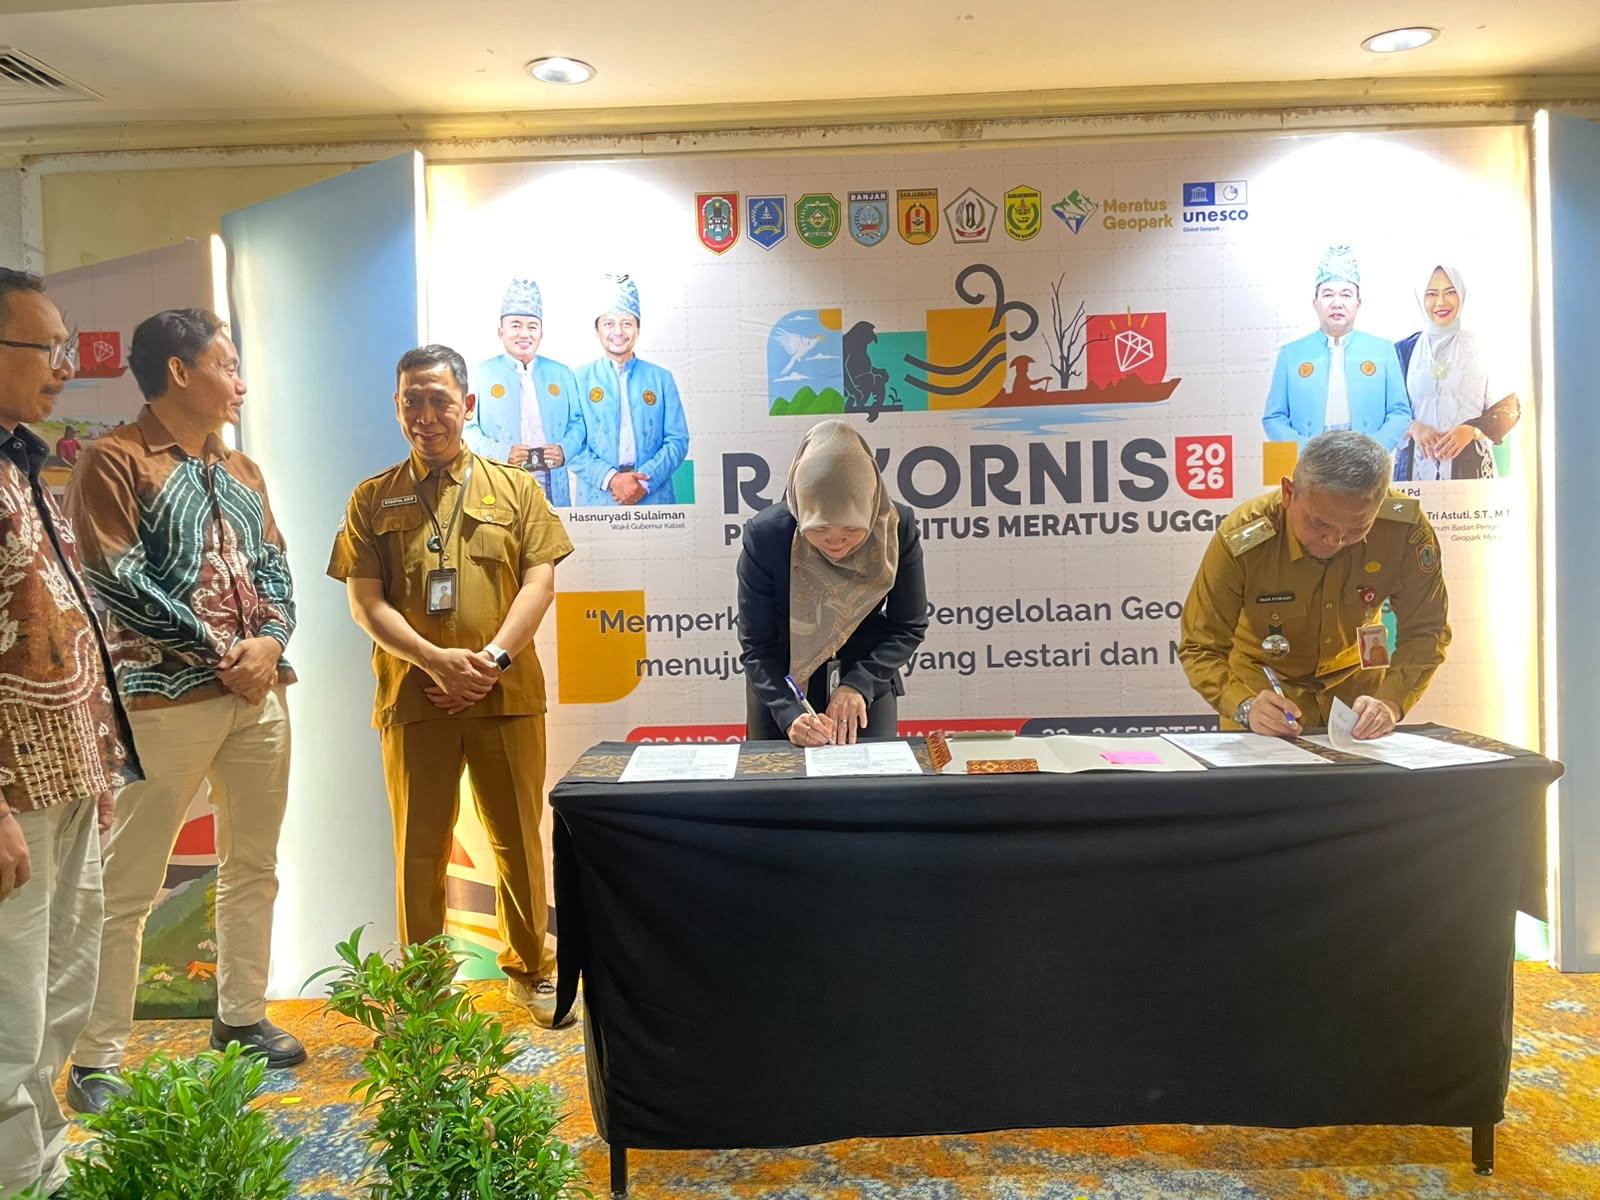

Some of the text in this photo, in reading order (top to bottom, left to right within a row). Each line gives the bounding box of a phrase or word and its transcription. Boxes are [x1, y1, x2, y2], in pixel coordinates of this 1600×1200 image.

[850, 193, 886, 201] BANJAR
[1103, 199, 1168, 213] Meratus
[1103, 214, 1173, 232] Geopark
[1183, 209, 1248, 223] unesco
[1186, 443, 1225, 467] 20
[722, 437, 1169, 515] RORNIS
[1187, 466, 1224, 490] 26
[569, 510, 685, 523] Hasnuryadi Sulaiman
[998, 511, 1139, 537] MERATUS
[1427, 512, 1439, 520] Tri
[903, 649, 976, 676] yang
[986, 641, 1090, 669] Lestari
[1100, 641, 1158, 666] dan
